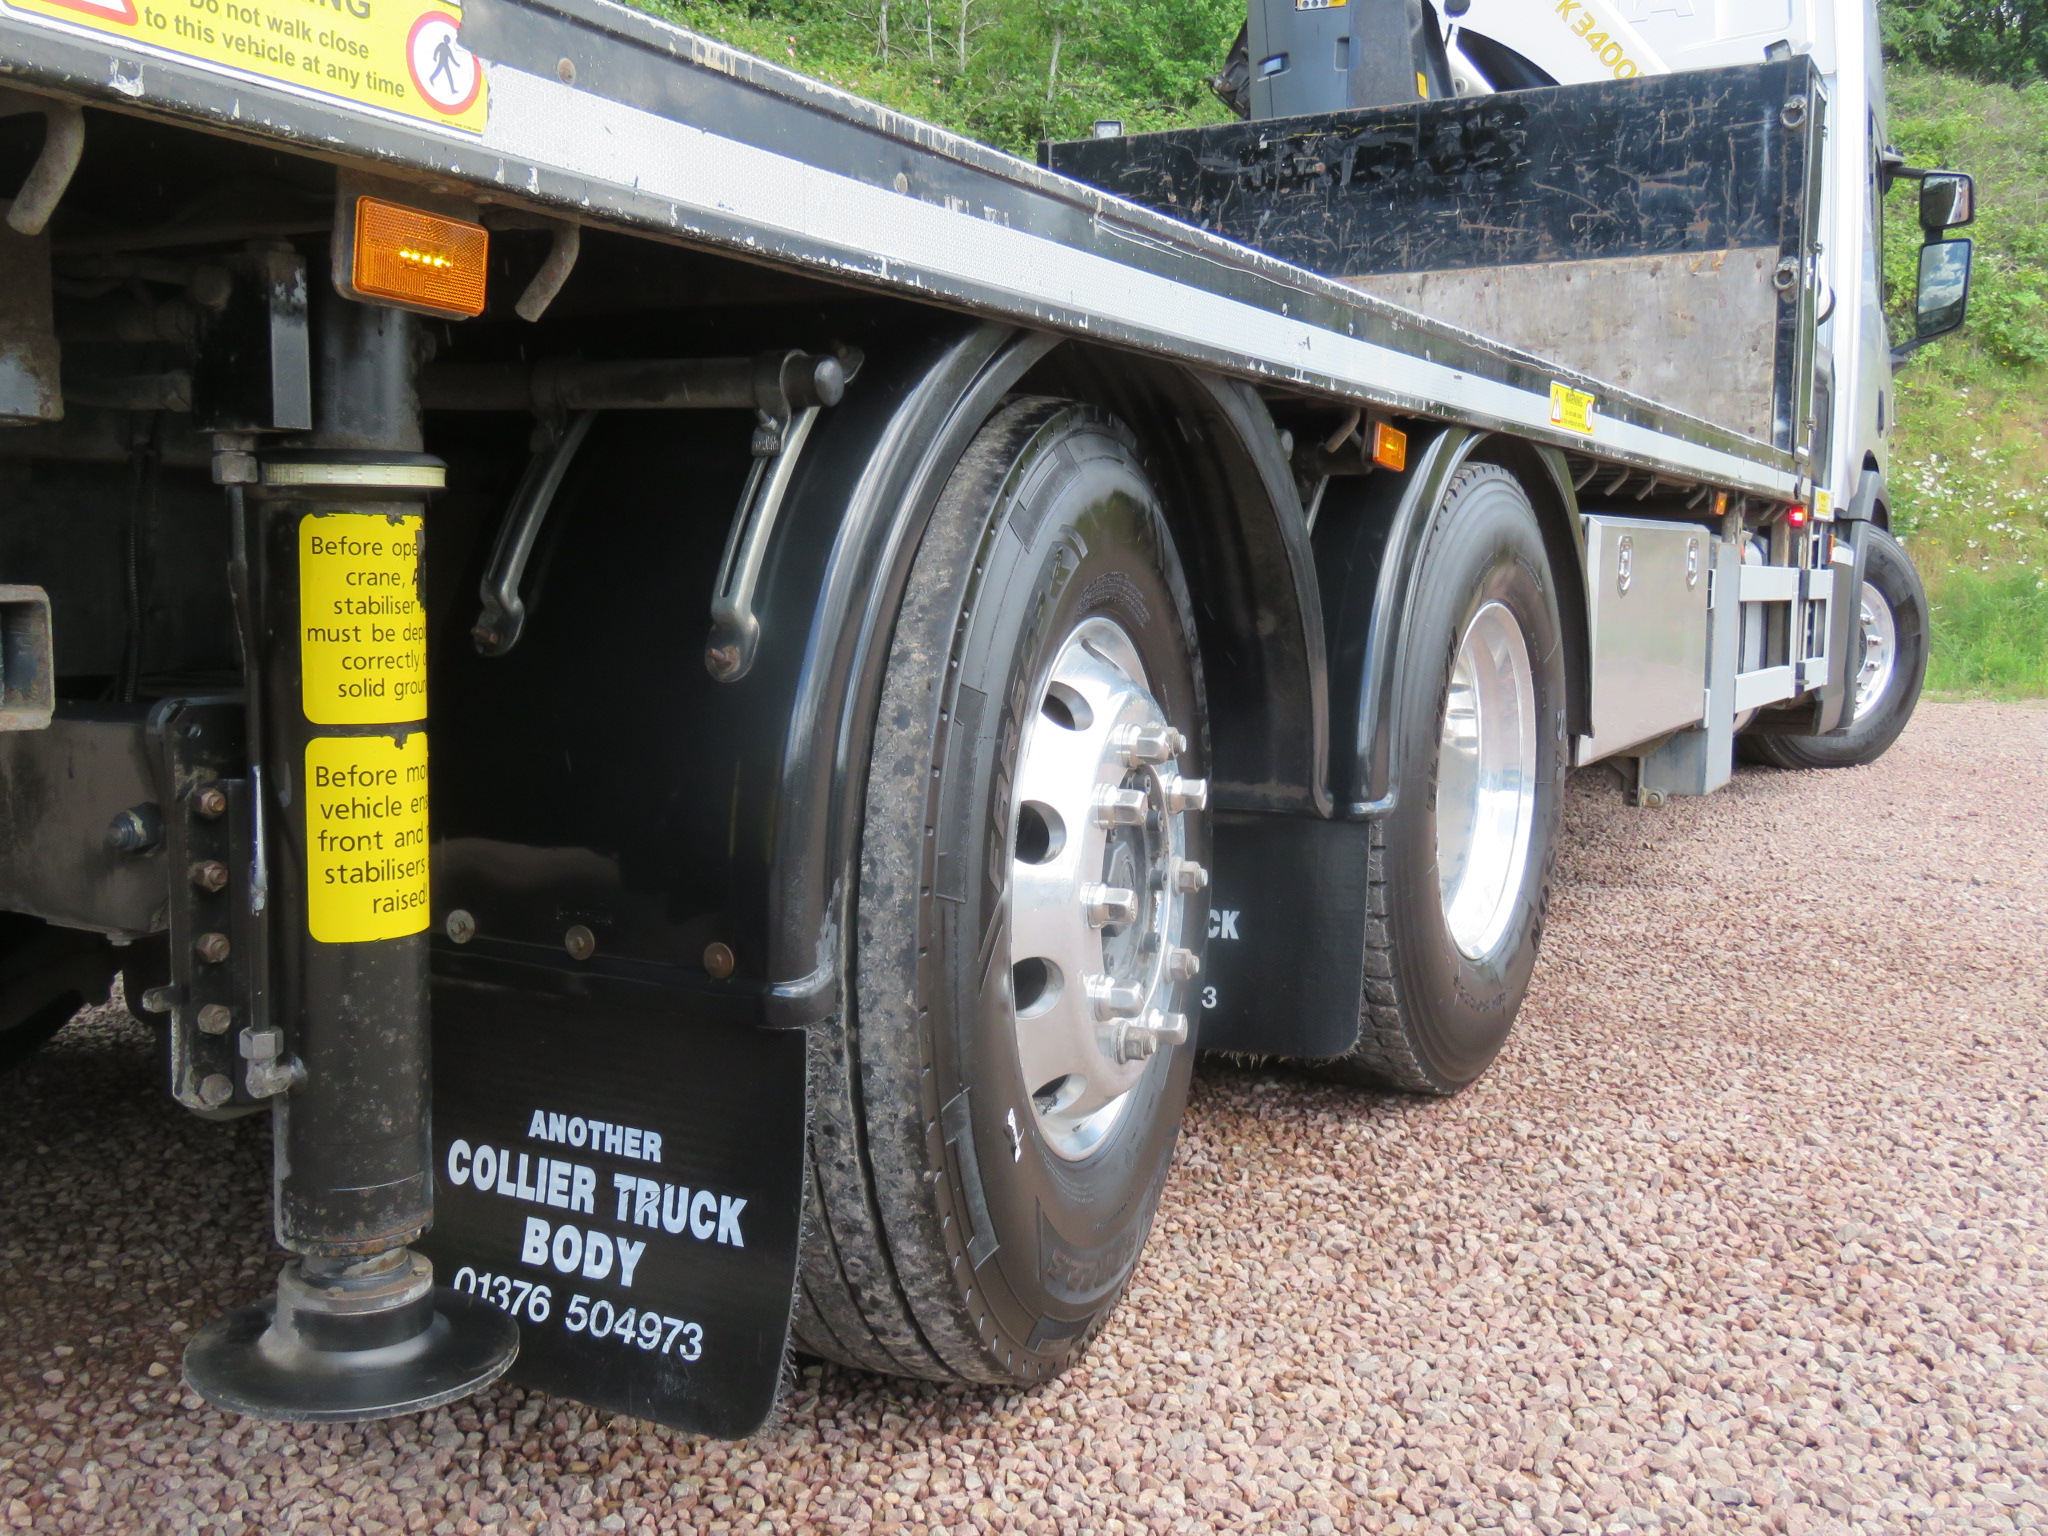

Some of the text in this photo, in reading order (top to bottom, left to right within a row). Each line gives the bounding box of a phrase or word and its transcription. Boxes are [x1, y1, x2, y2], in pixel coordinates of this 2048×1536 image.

[227, 3, 260, 27] not
[266, 14, 313, 43] walk
[319, 30, 370, 59] close
[145, 6, 406, 98] to this vehicle at any time
[311, 536, 383, 556] Before
[346, 571, 406, 589] crane,
[334, 596, 415, 615] stabiliser
[307, 625, 362, 643] must
[372, 623, 395, 643] be
[342, 649, 420, 672] correctly
[338, 678, 385, 698] solid
[315, 764, 397, 788] Before
[320, 795, 402, 820] vehicle
[318, 821, 424, 852] front and
[325, 857, 426, 884] stabilisers
[373, 882, 428, 914] raised!
[1201, 986, 1217, 1009] 3
[528, 1109, 662, 1163] ANOTHER
[448, 1139, 748, 1248] COLLIER TRUCK
[521, 1216, 646, 1288] BODY
[453, 1266, 704, 1361] 01376 504973
